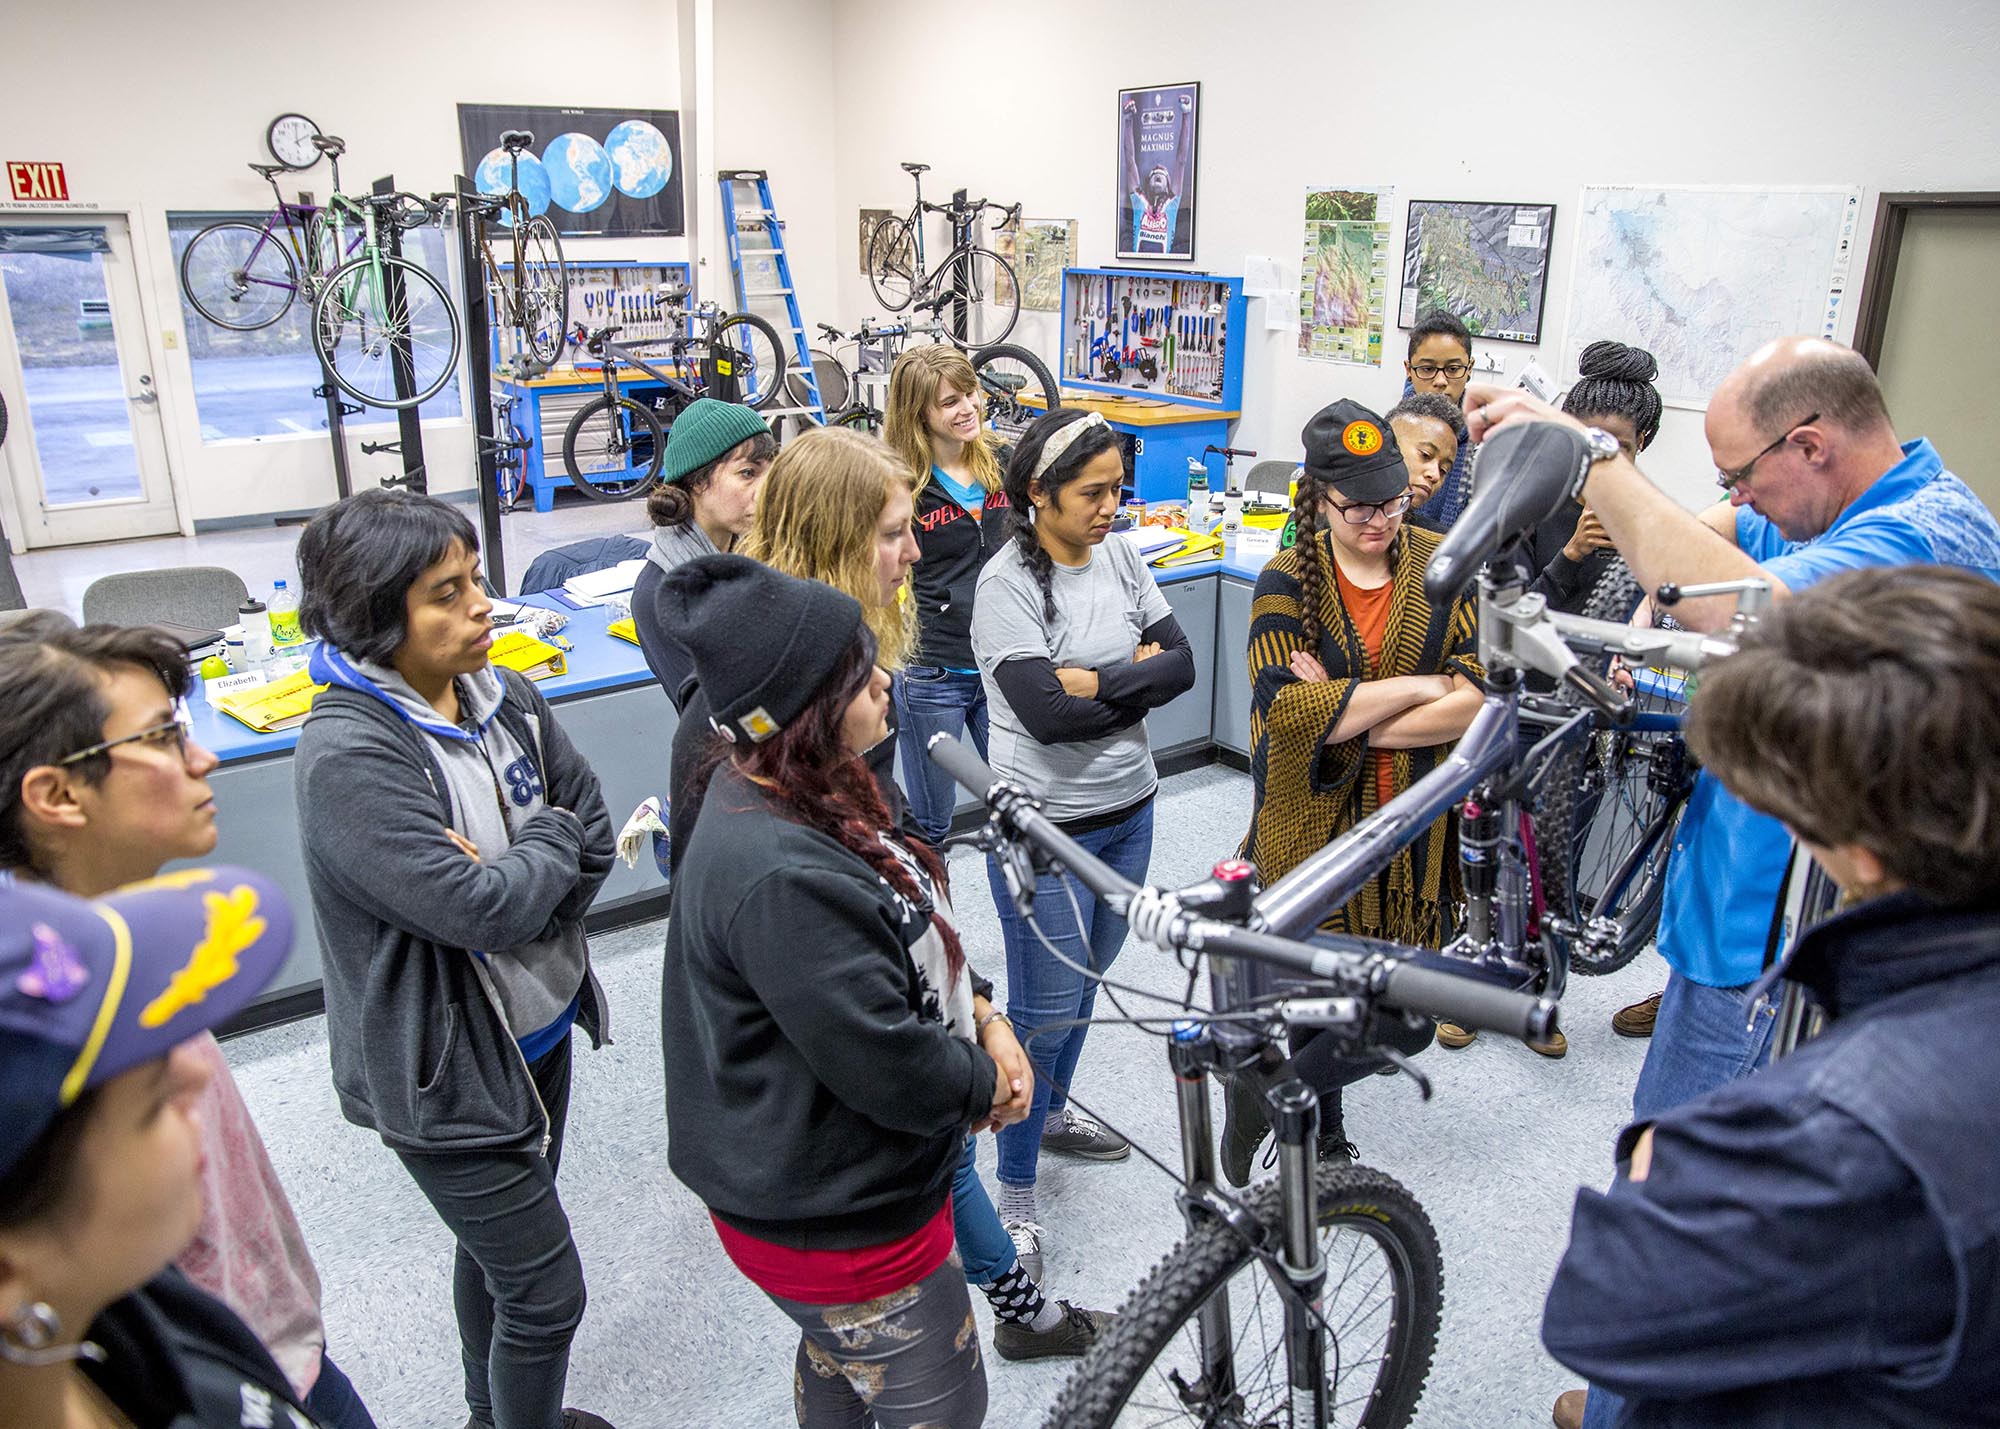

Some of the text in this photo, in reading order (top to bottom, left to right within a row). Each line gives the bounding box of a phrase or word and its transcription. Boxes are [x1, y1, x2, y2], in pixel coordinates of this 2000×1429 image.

[1141, 132, 1174, 142] MAGNUS
[1141, 142, 1174, 152] MAXIMUS
[10, 164, 62, 198] EXIT
[1140, 231, 1166, 240] Bianchi
[1136, 439, 1142, 453] 8
[1282, 520, 1296, 547] 6
[217, 675, 257, 689] Elizabeth
